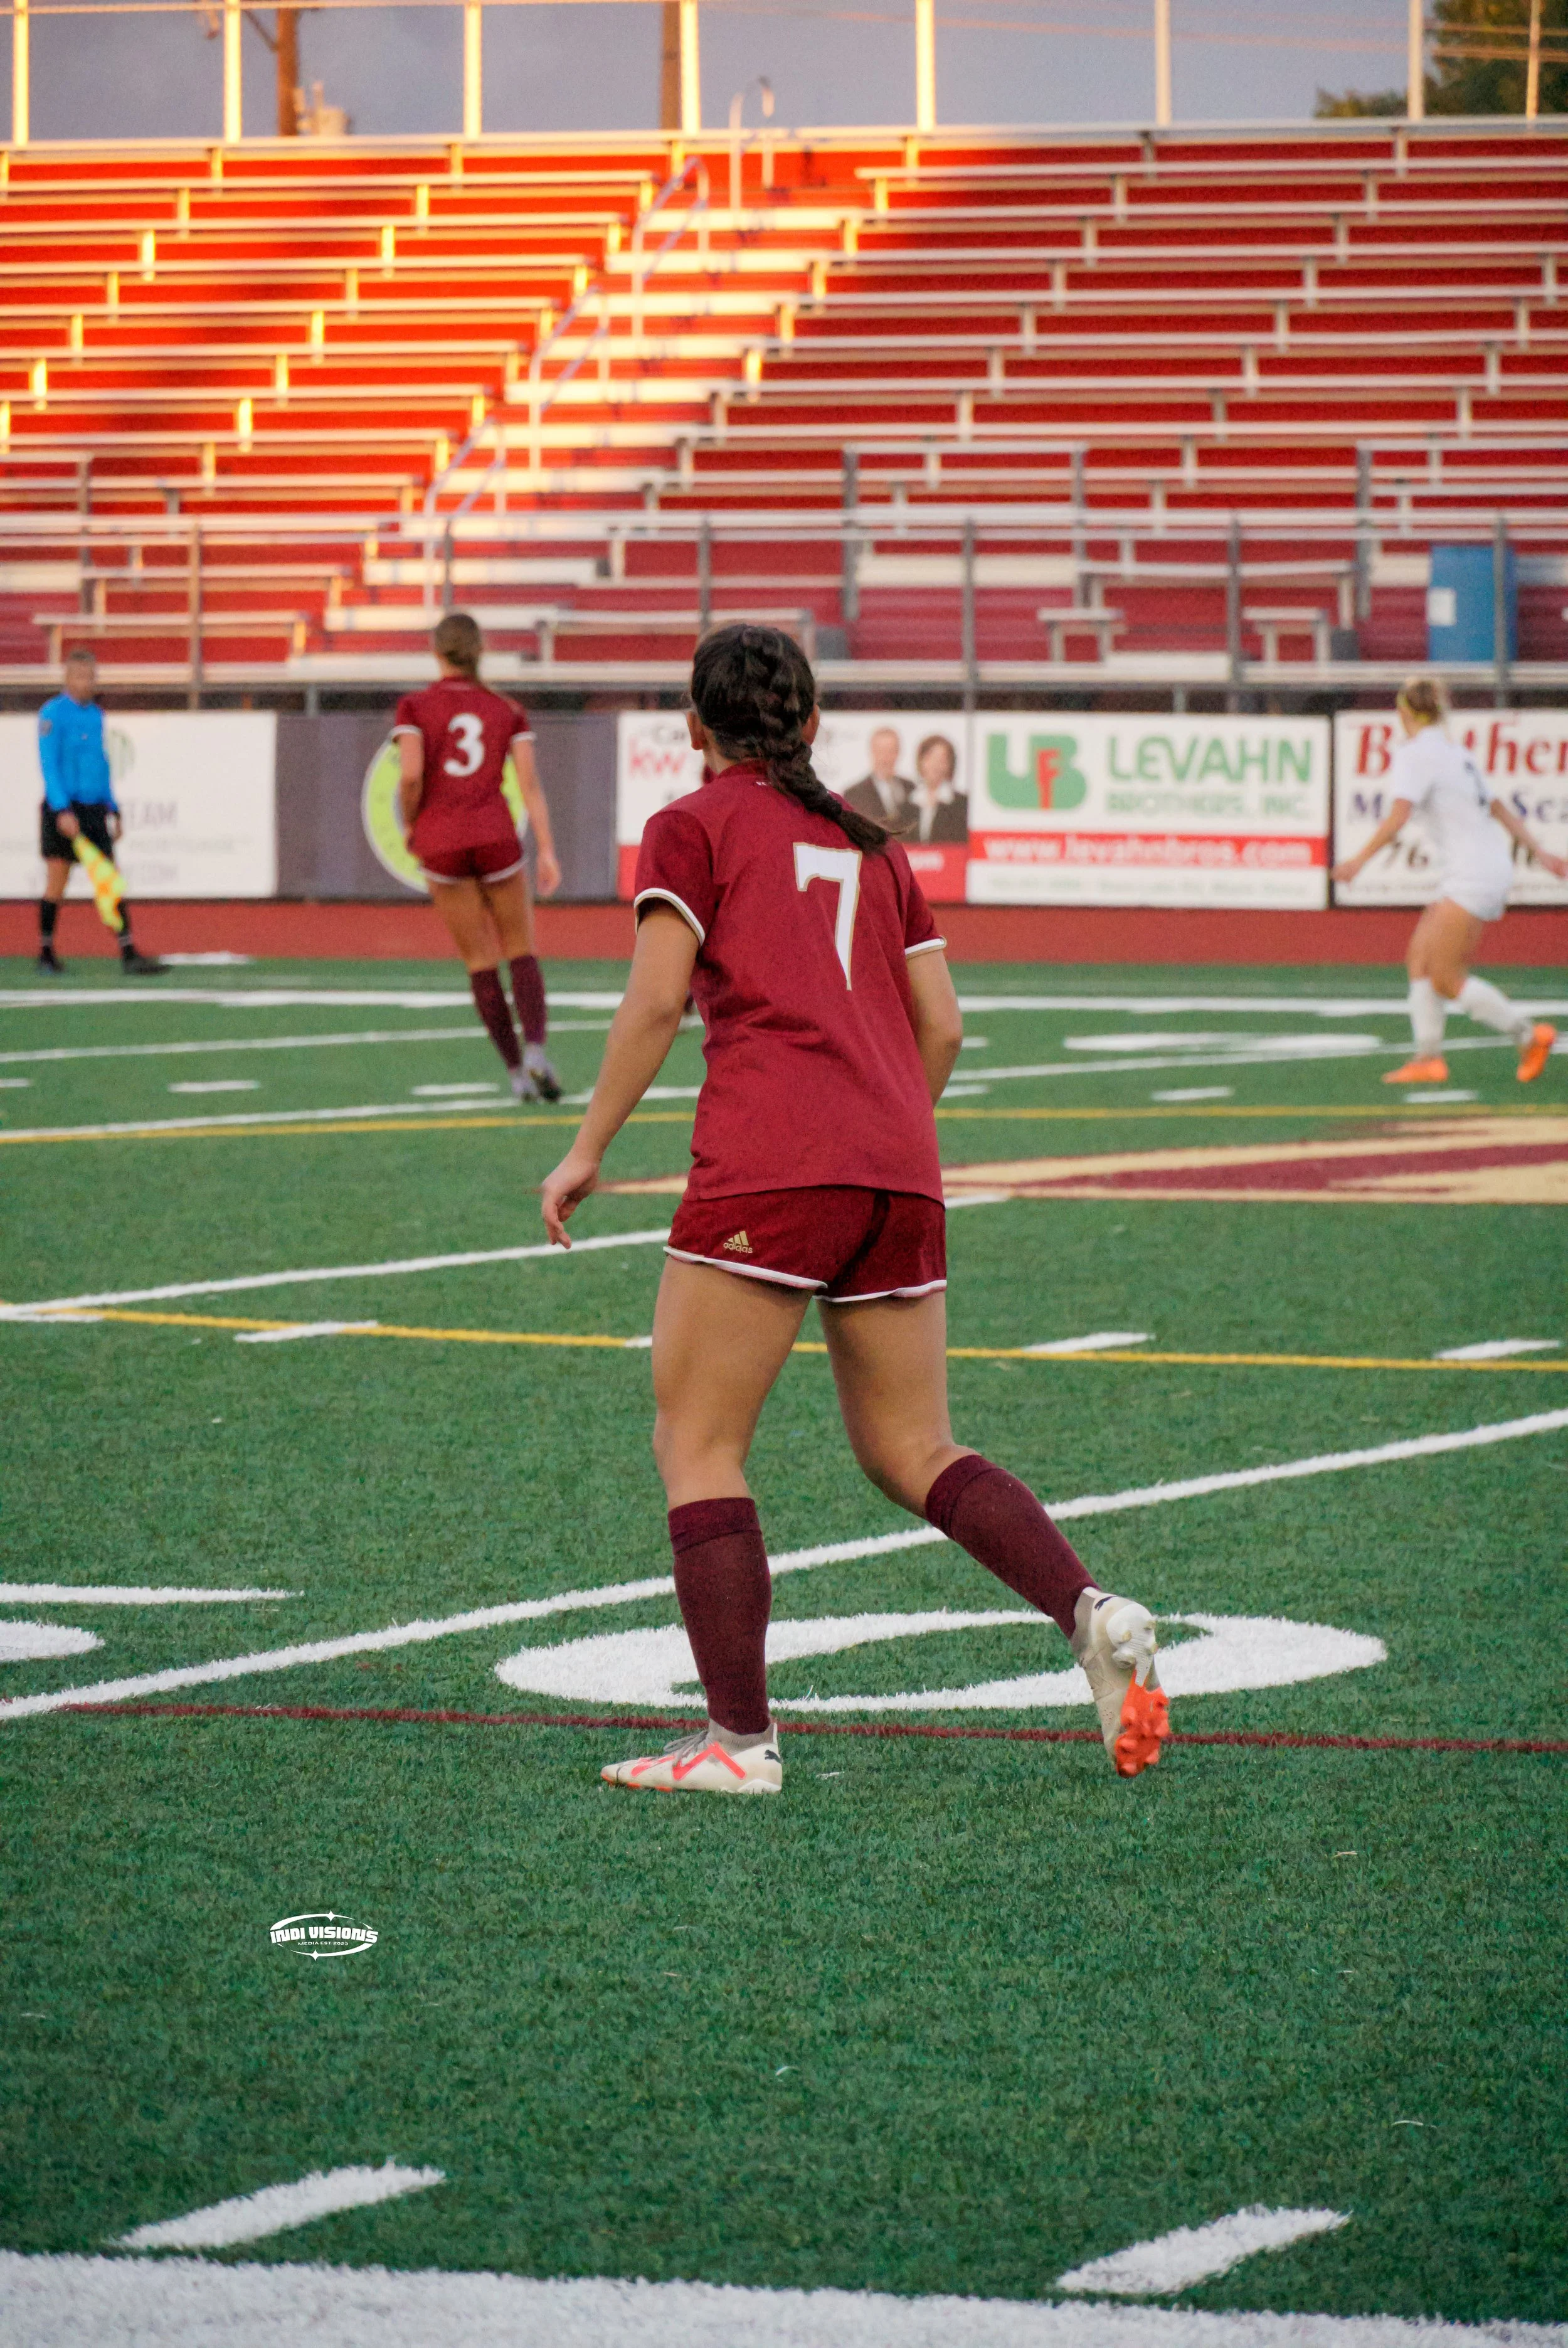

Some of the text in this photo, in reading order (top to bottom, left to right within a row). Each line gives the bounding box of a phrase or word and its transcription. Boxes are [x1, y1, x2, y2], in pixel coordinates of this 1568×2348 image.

[443, 713, 485, 777] 3
[1108, 735, 1313, 783] LEVAHN
[793, 842, 862, 991] 7
[723, 1242, 753, 1253] adidas
